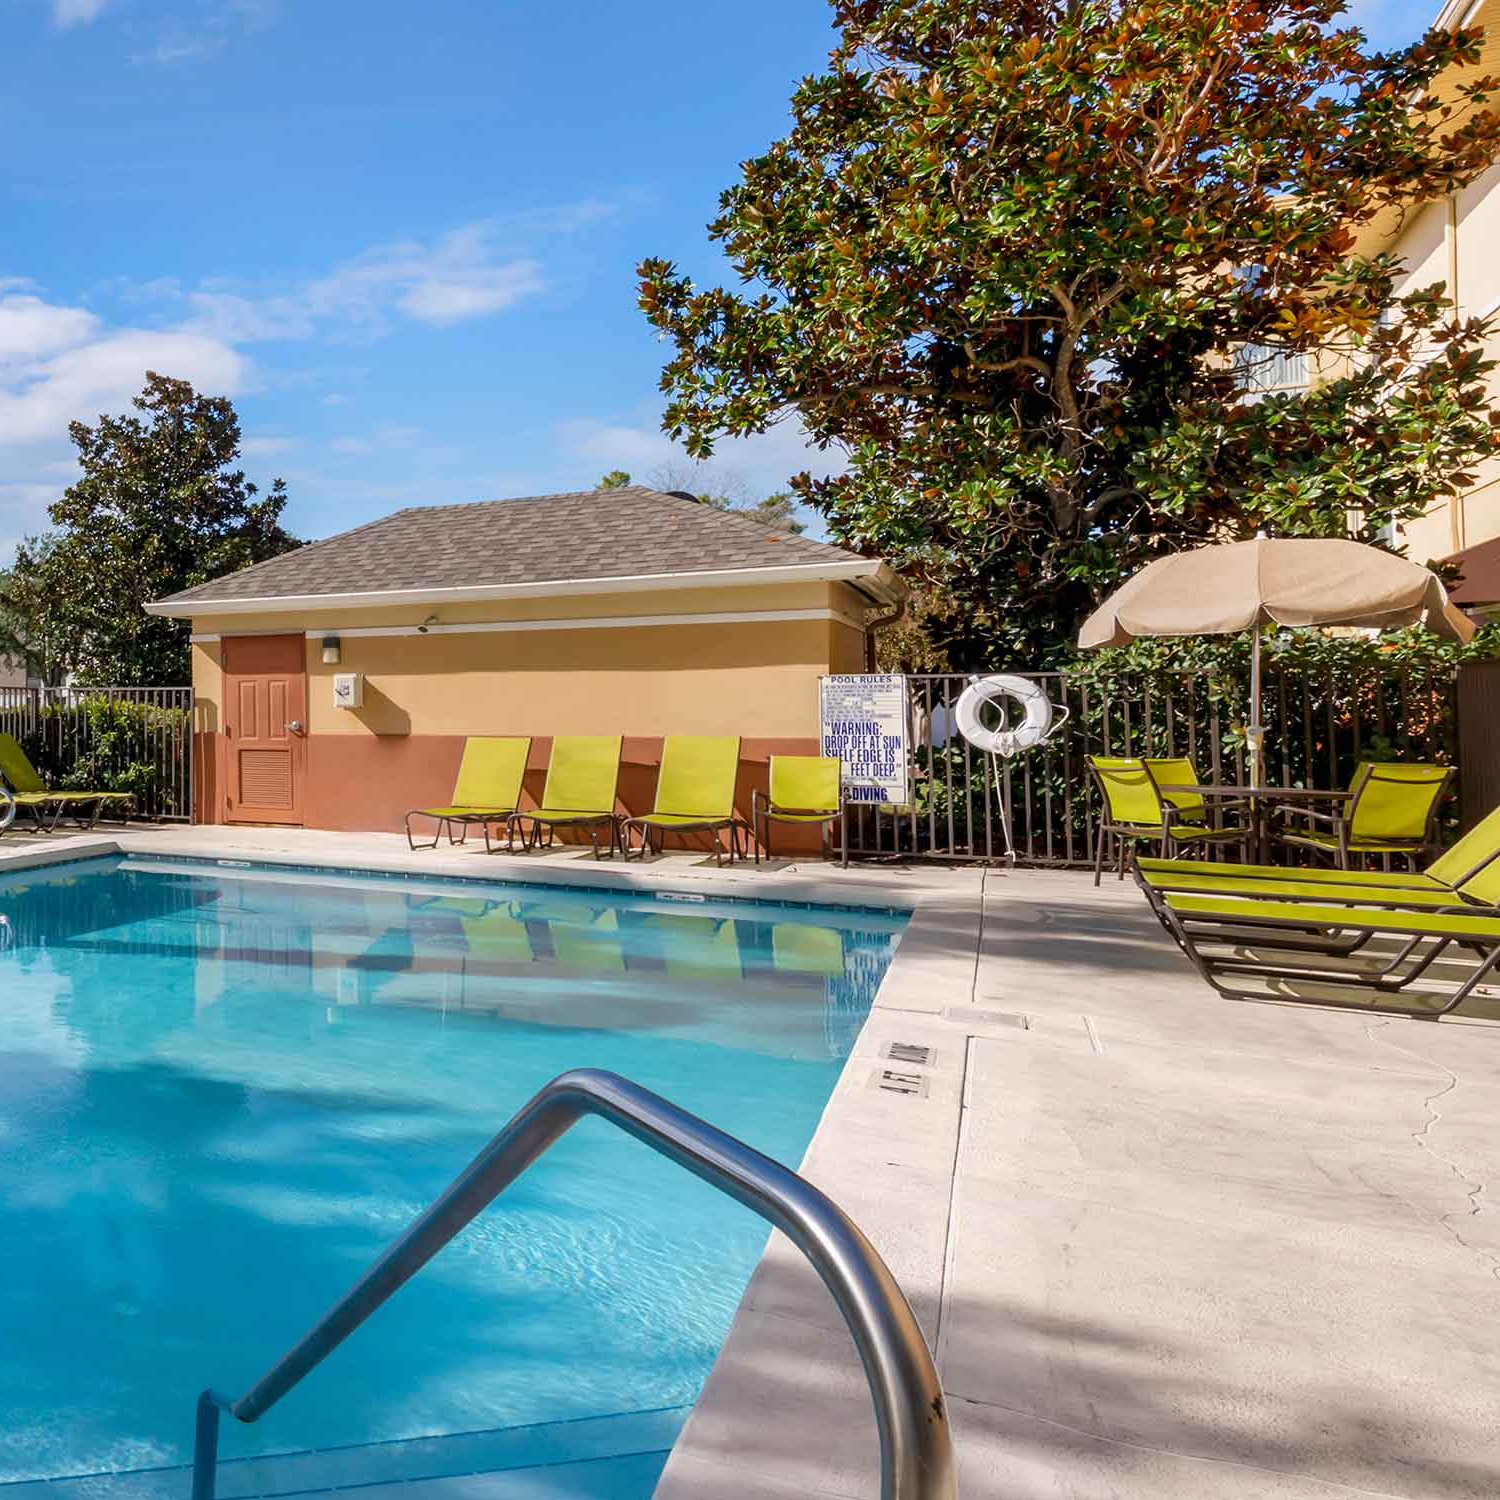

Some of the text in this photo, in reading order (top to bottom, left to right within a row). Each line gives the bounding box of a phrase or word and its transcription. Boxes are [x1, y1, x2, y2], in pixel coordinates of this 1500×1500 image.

[831, 675, 892, 684] POOL RULES
[825, 736, 901, 749] DROP OFF AT SUN
[857, 749, 882, 762] EDGE
[885, 749, 895, 762] IS
[851, 763, 870, 776] FEET
[852, 787, 888, 801] DIVING
